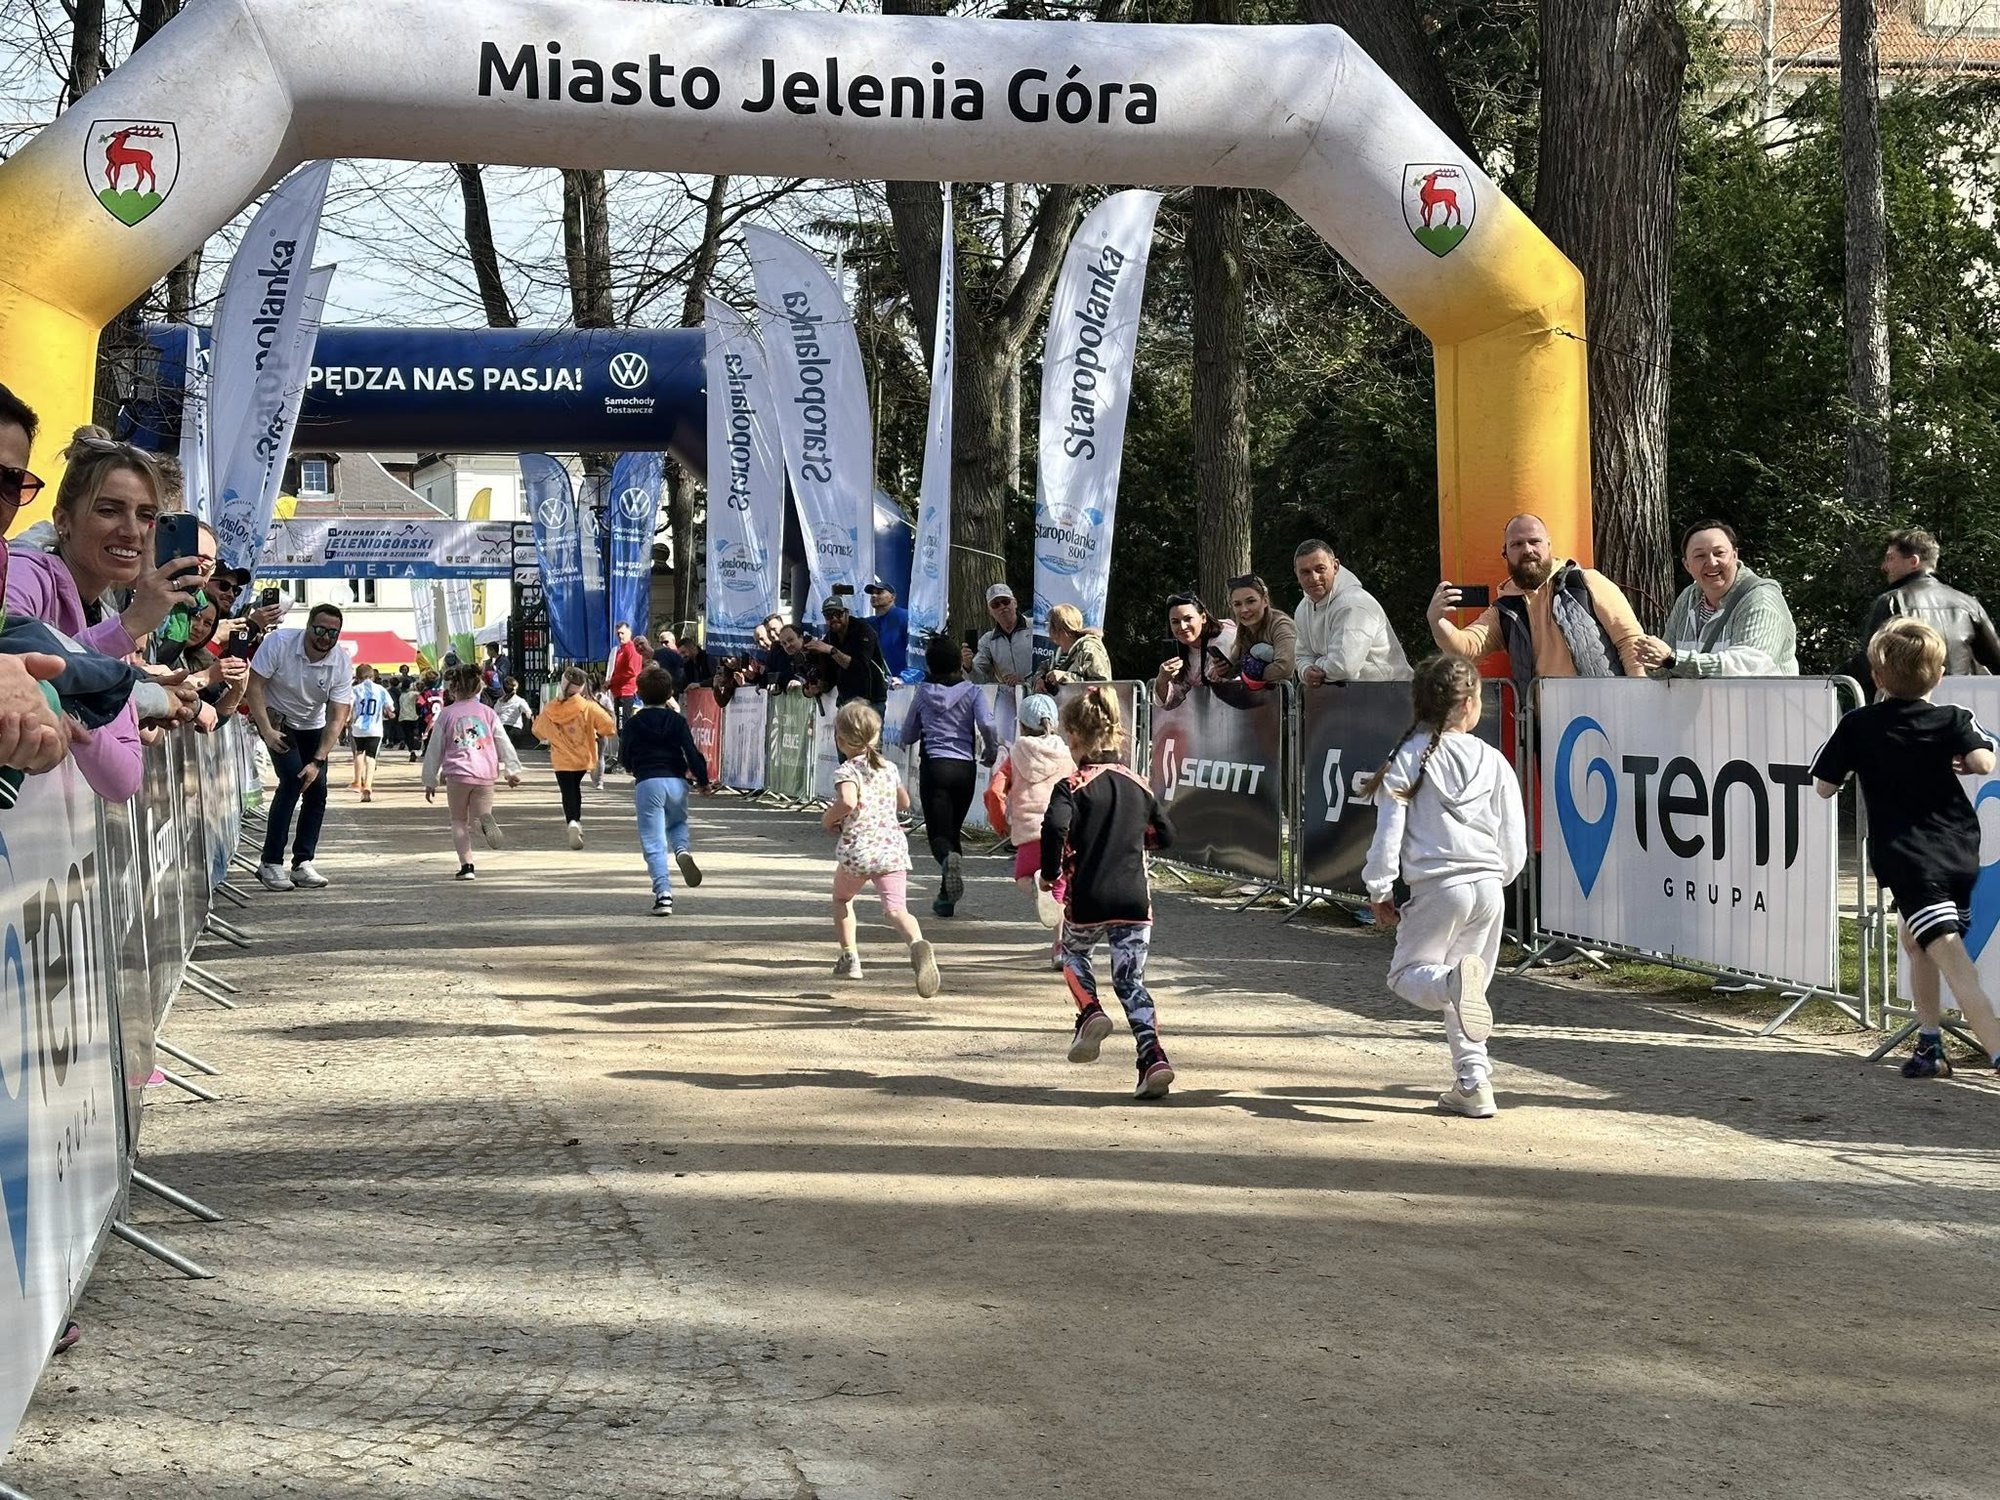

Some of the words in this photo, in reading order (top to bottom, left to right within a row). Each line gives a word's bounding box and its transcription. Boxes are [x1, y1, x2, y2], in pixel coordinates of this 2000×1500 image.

[478, 41, 721, 110] Miasto
[741, 56, 985, 121] Jelenia
[1008, 65, 1157, 125] Góra
[1063, 242, 1125, 461] Staropolanka
[413, 366, 475, 391] NAS
[483, 366, 583, 391] PASJA!
[604, 396, 656, 408] Samochody
[606, 406, 654, 415] Dostawcze
[325, 537, 434, 550] JELENIOGÓRSKI
[1068, 545, 1086, 560] 800
[344, 563, 417, 576] META
[359, 698, 377, 716] 10
[1178, 757, 1266, 795] SCOTT
[1663, 876, 1767, 913] GRUPA
[56, 1086, 98, 1183] GRUPA
